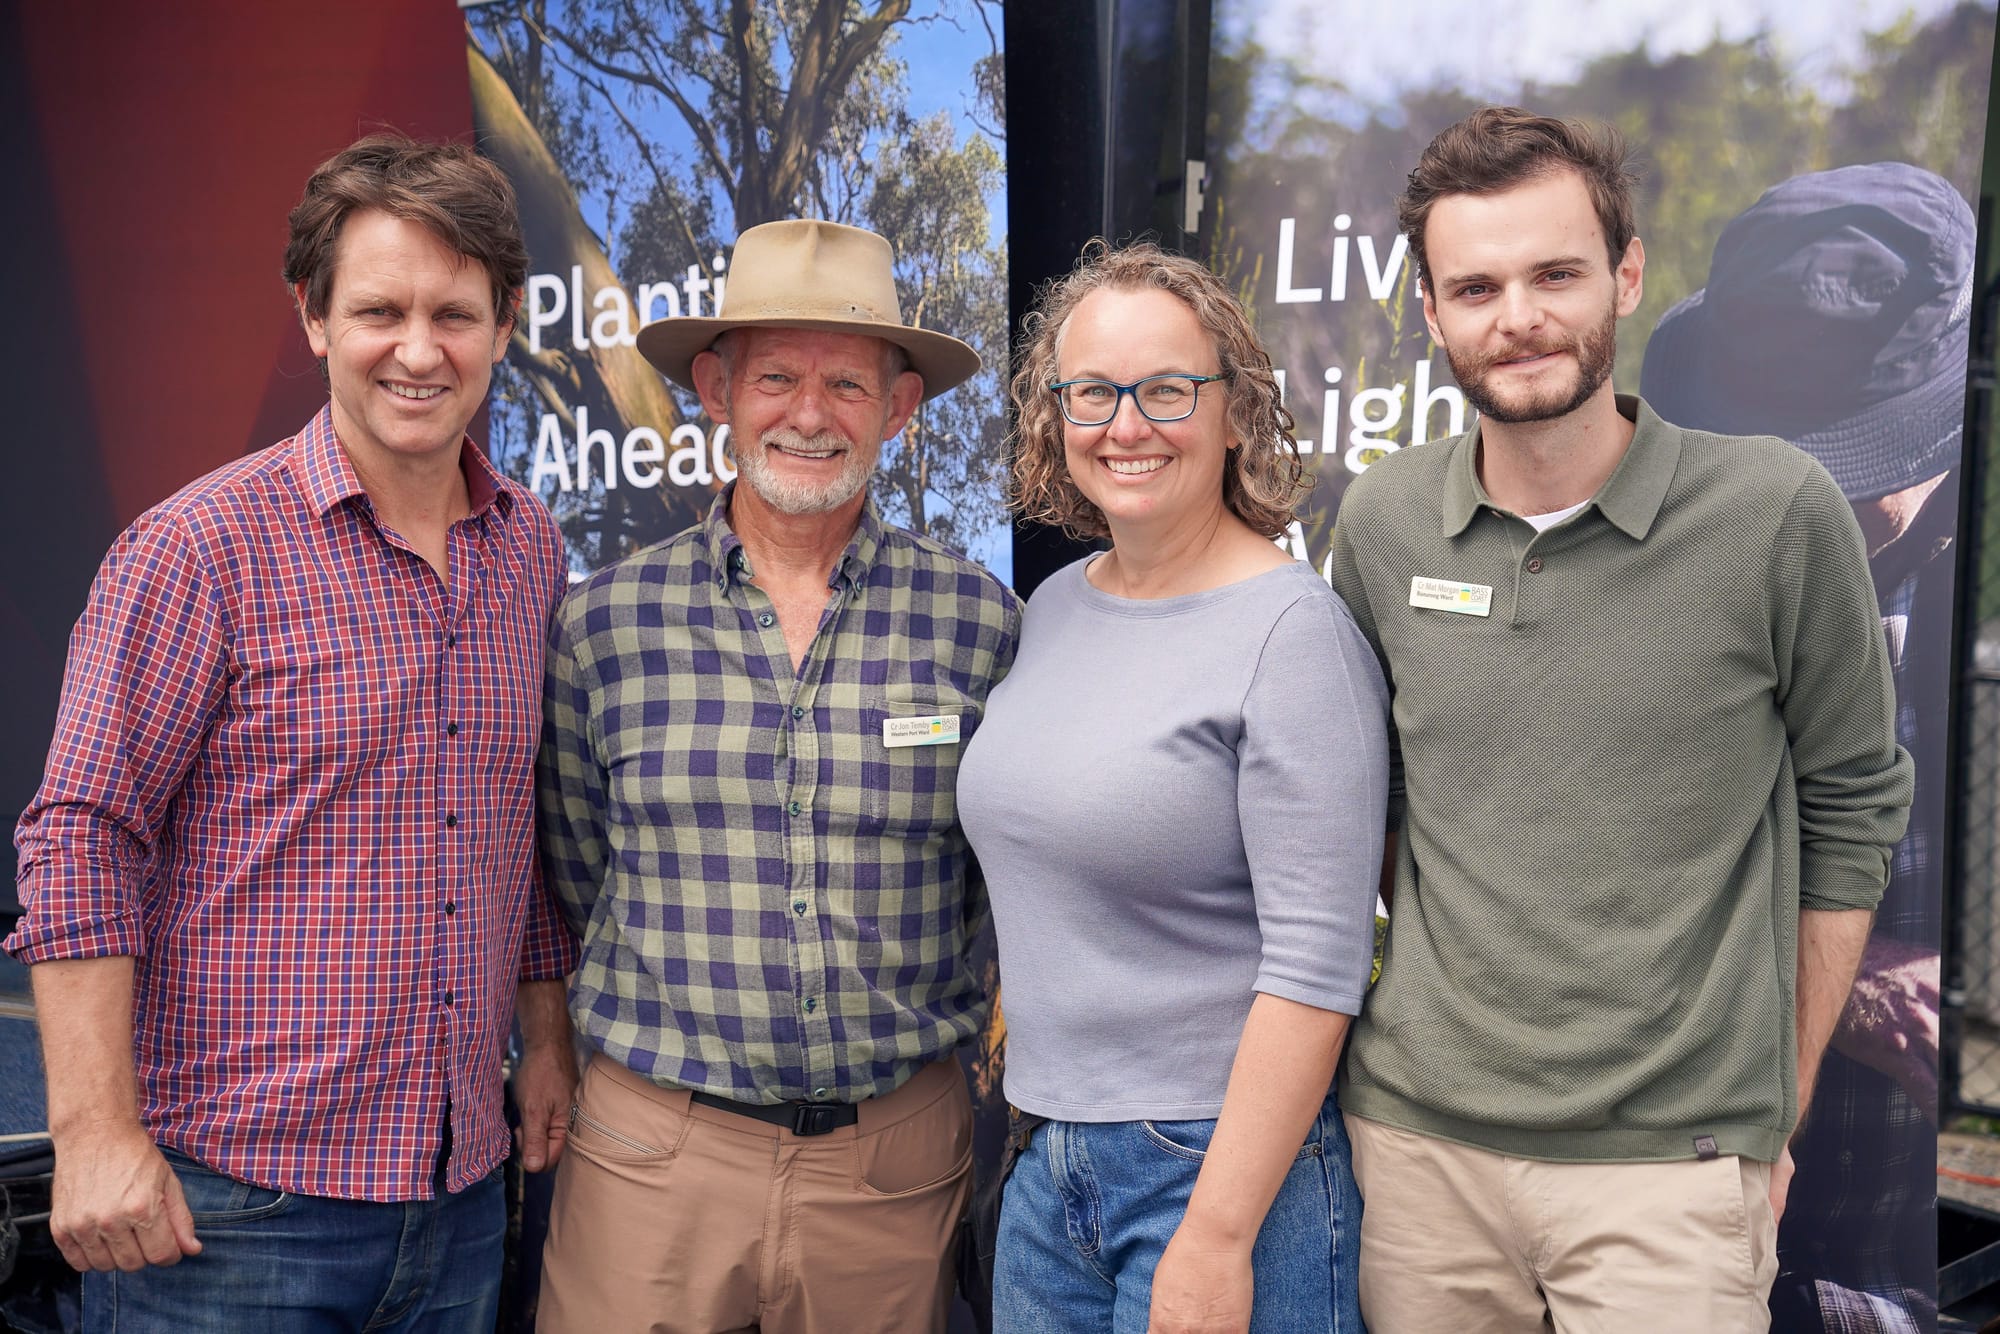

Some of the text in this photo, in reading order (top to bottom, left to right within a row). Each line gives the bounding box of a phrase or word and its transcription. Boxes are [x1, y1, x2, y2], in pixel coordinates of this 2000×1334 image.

[1275, 213, 1424, 304] Liv
[1273, 359, 1480, 475] Ligh
[1471, 586, 1489, 596] BASS
[899, 721, 910, 730] Jon
[911, 720, 930, 730] Temby
[942, 717, 958, 725] BASS
